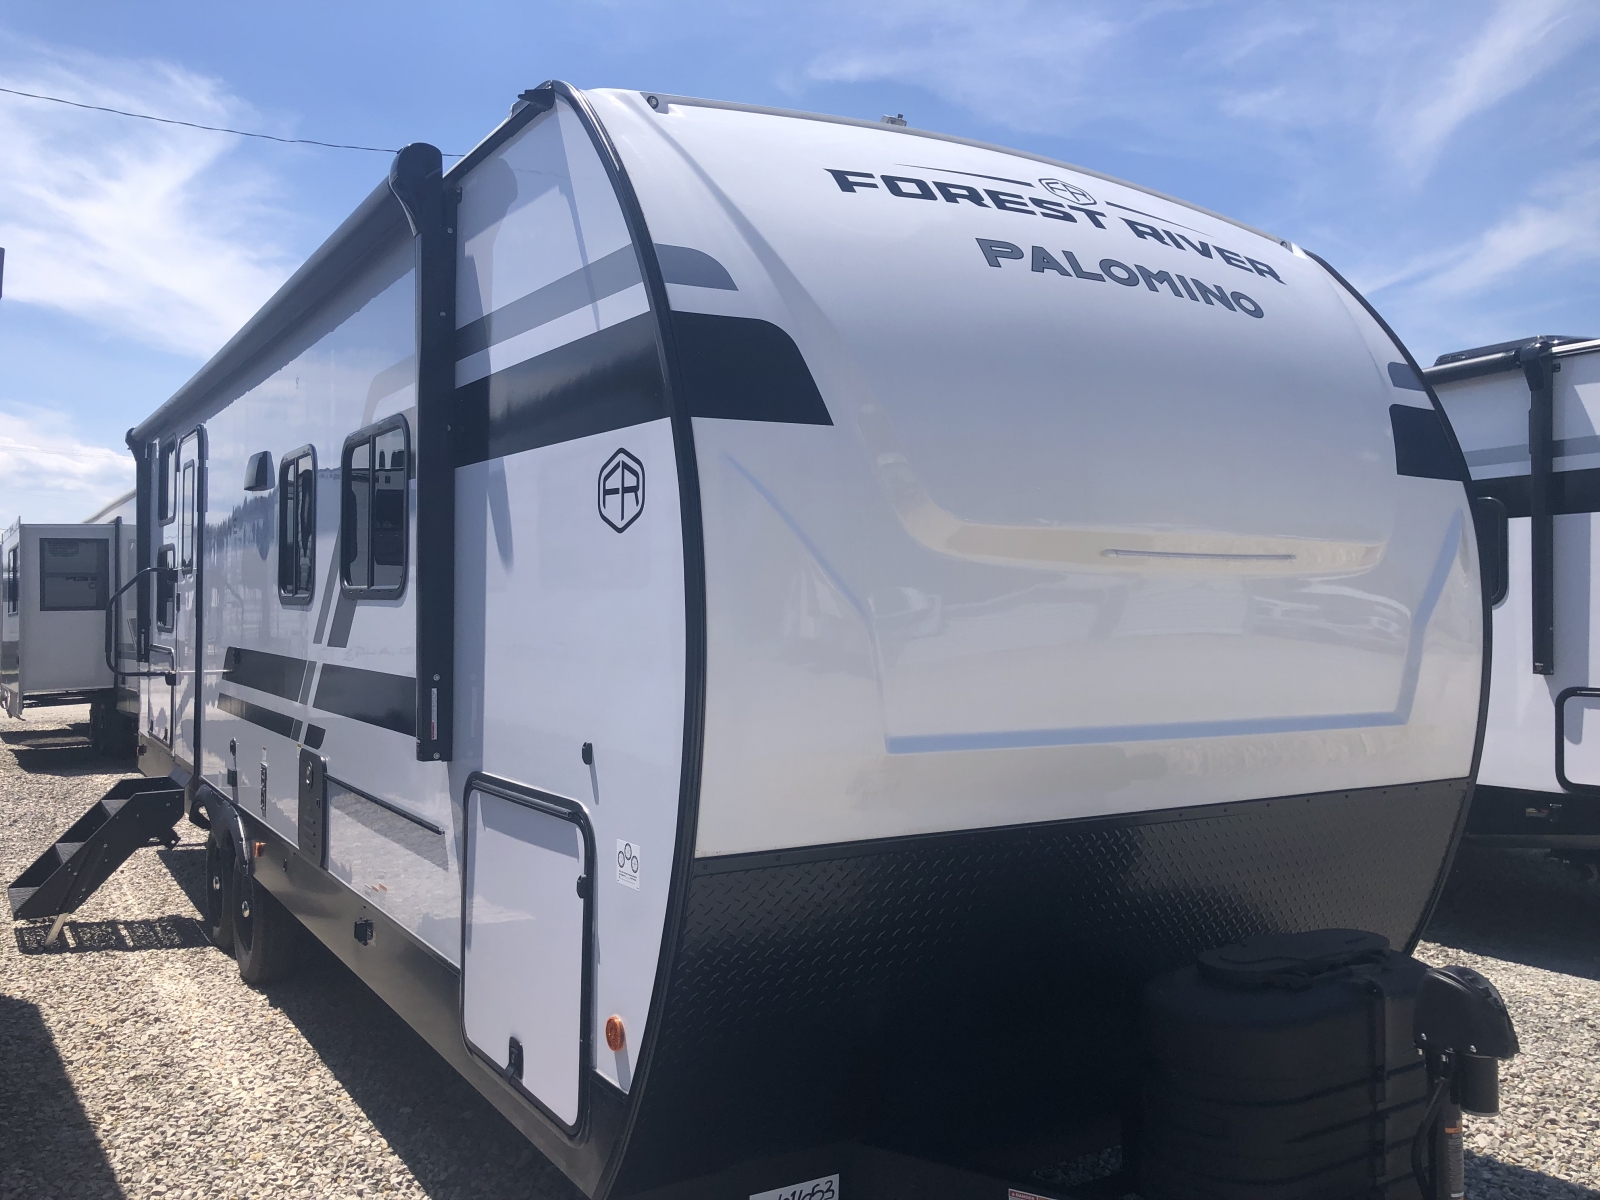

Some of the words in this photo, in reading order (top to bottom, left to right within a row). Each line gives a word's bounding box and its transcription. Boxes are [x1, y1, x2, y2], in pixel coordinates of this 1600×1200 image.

[822, 168, 1107, 230] FOREST
[1118, 216, 1287, 285] RIVER
[975, 237, 1265, 319] PALOMINO
